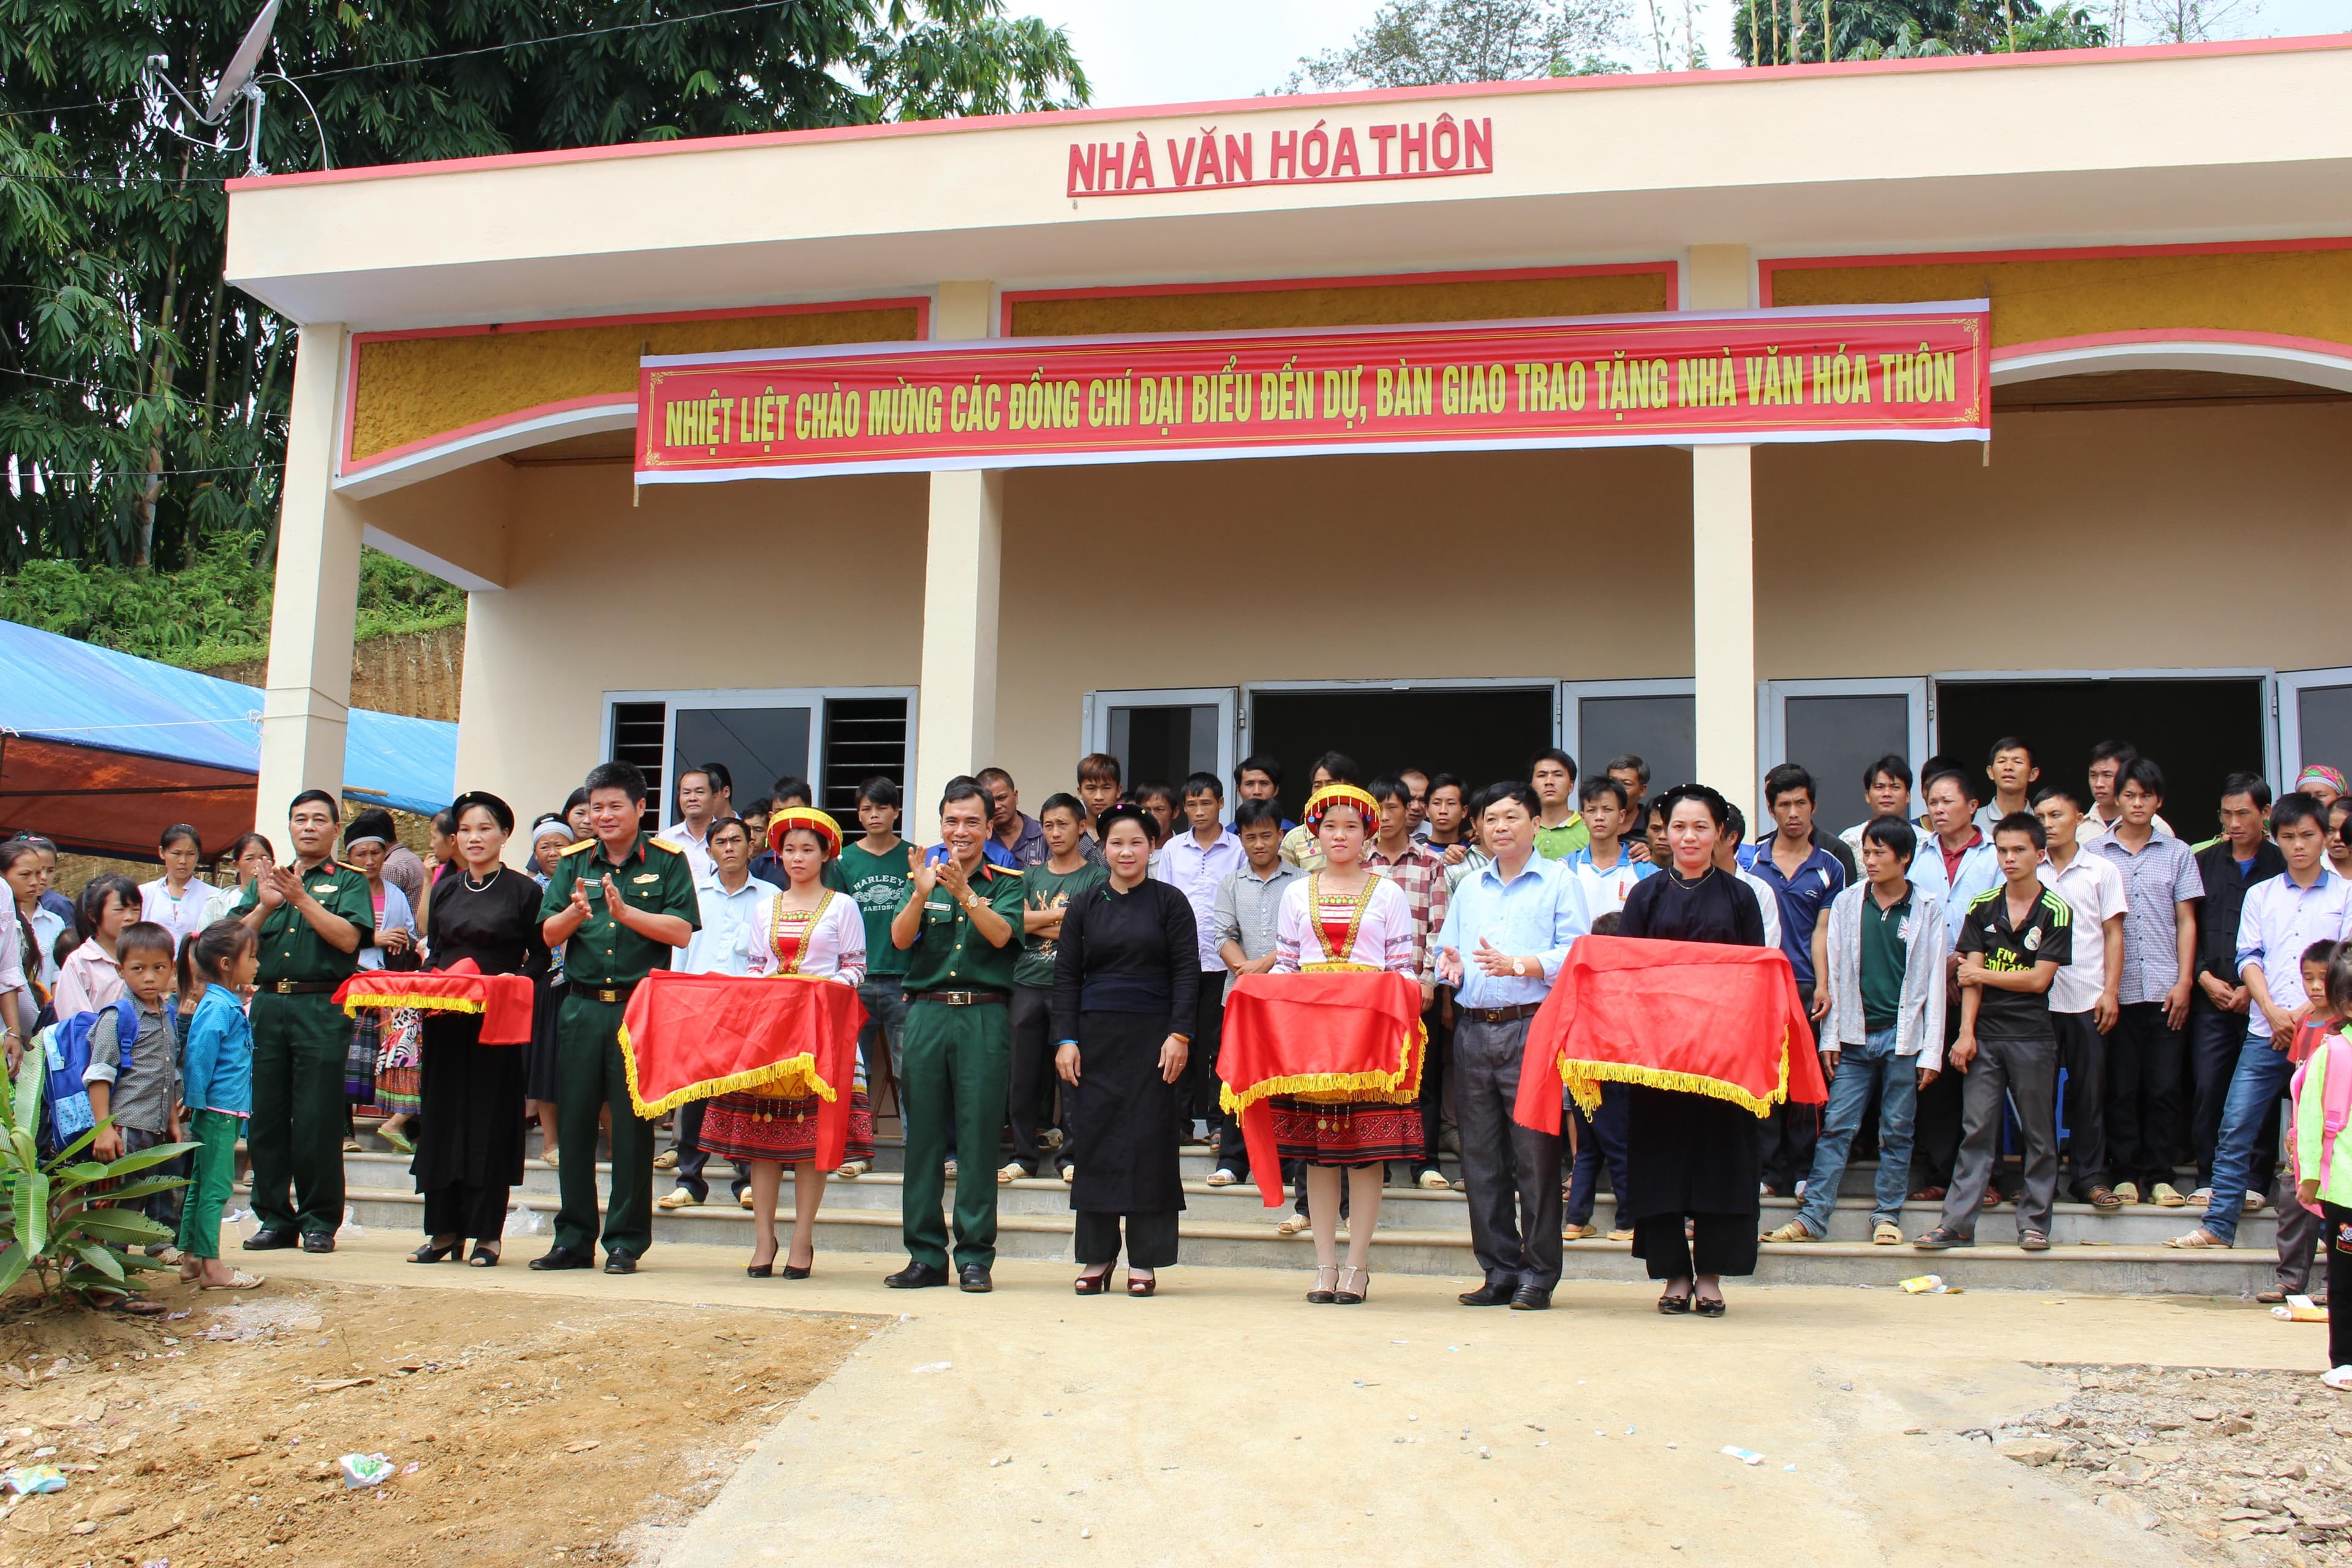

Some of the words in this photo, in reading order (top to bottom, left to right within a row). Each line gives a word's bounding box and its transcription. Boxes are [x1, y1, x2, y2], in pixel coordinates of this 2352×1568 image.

[1069, 130, 1155, 190] NHÀ
[1167, 125, 1253, 186] VĂN
[1270, 118, 1361, 178] HÓA
[1369, 111, 1492, 174] THÔN
[665, 388, 734, 456] NHIỆT
[739, 385, 790, 453] LIỆT
[795, 381, 861, 441] CHÀO
[867, 376, 943, 437] MỪNG
[950, 374, 1002, 433] CÁC
[1008, 366, 1080, 431] ĐỒNG
[1087, 369, 1133, 428] CHÍ
[1139, 376, 1184, 436] ĐẠI
[1191, 354, 1253, 423] BIỂU
[1260, 355, 1315, 421] ĐẾN
[1322, 364, 1368, 429] DỰ,
[1376, 358, 1433, 418] BÀN
[1442, 363, 1507, 416] GIAO
[1514, 360, 1587, 413] TRAO
[1594, 350, 1669, 421] TẶNG
[1678, 345, 1738, 408] NHÀ
[1745, 344, 1804, 406] VĂN
[1812, 342, 1872, 405] HÓA
[1878, 341, 1956, 404] THÔN
[853, 875, 905, 891] HARLEEY
[1996, 947, 2018, 963] Fly
